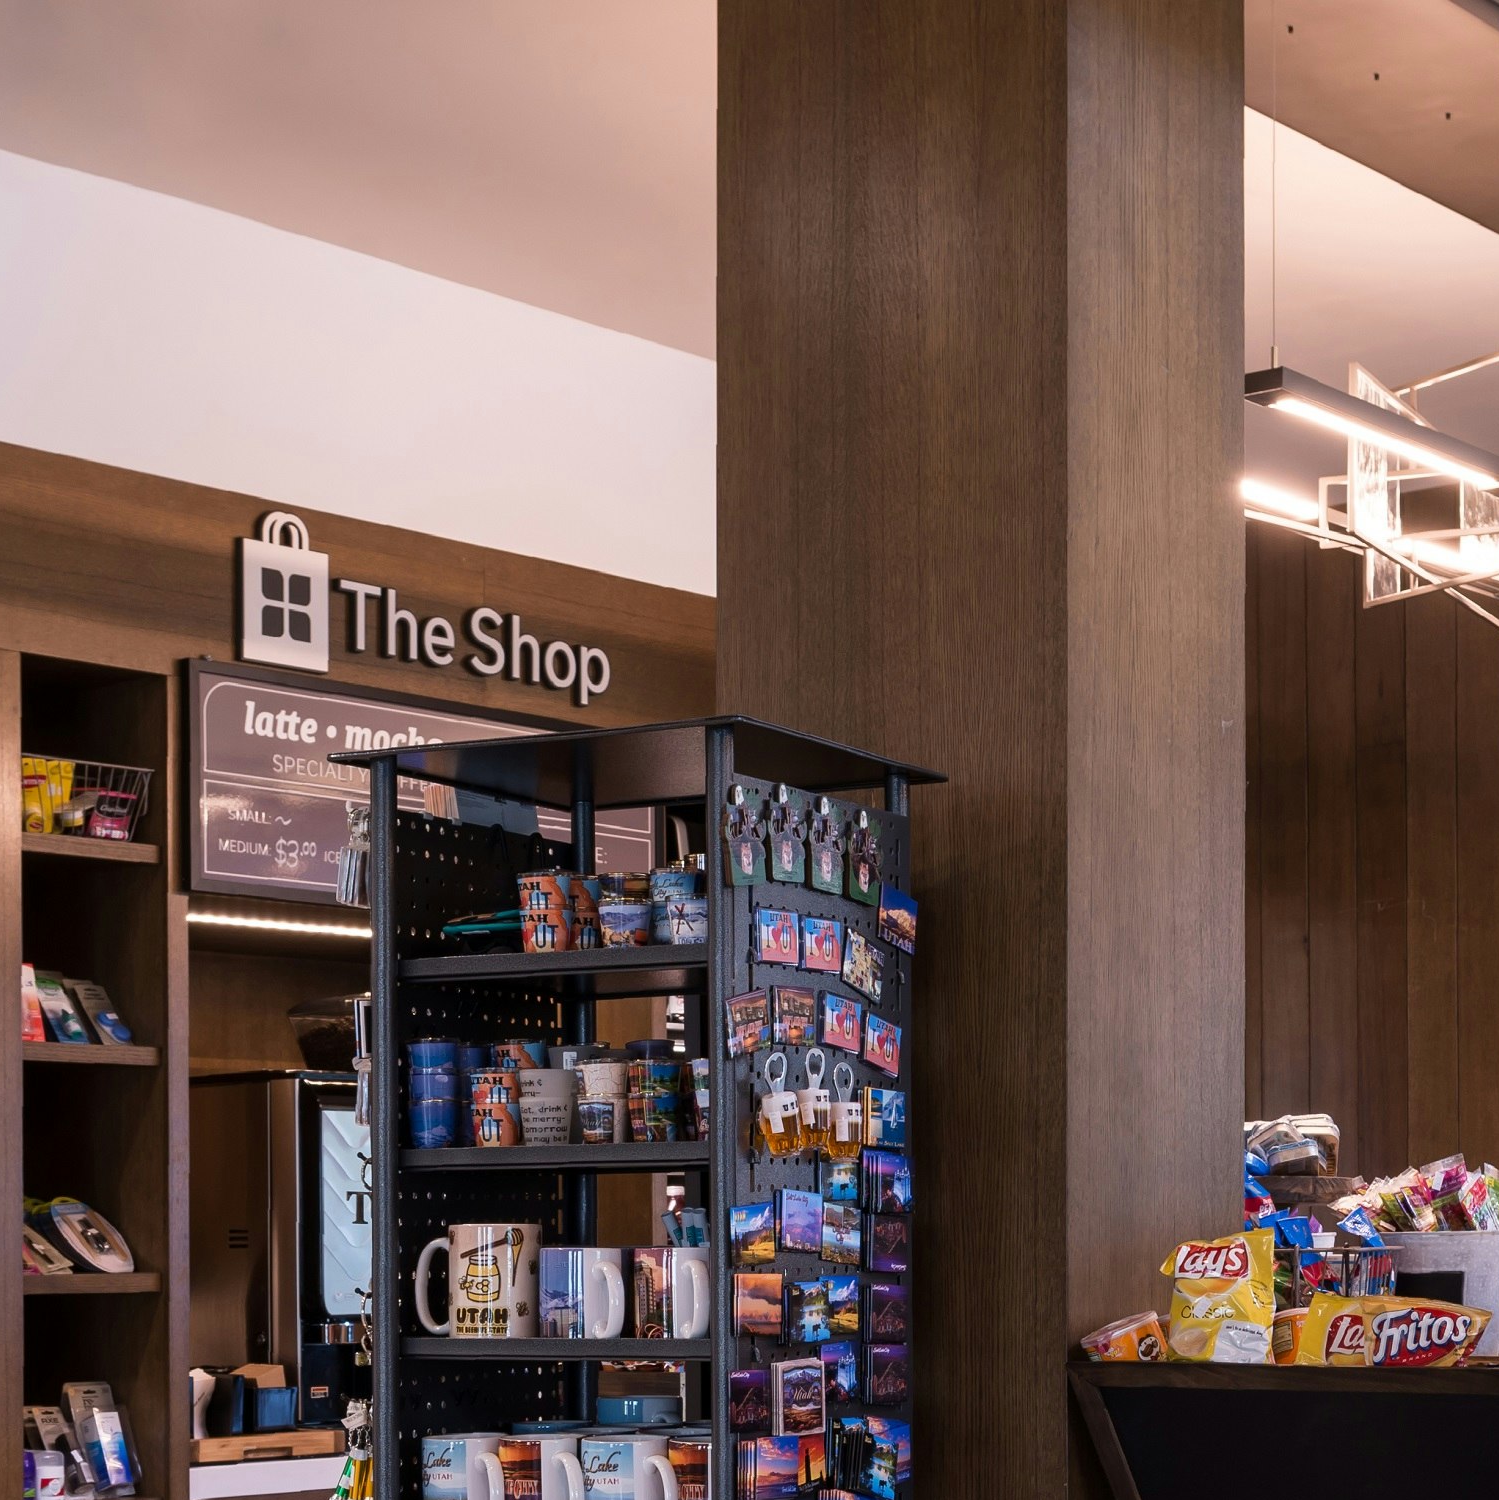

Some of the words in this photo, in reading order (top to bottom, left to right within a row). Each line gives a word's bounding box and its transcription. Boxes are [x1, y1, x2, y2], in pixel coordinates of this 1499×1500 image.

[336, 578, 456, 667] The
[466, 606, 612, 707] Shop
[244, 700, 318, 744] latte
[344, 724, 444, 751] moch
[272, 754, 369, 783] SPECIALTY
[218, 838, 272, 857] MEDIUM:
[521, 913, 549, 925] TAH
[769, 912, 790, 923] UTAH
[812, 920, 832, 932] UTAH
[534, 925, 559, 949] UT
[883, 931, 913, 951] UTAH
[834, 998, 853, 1012] UTAH
[875, 1019, 895, 1034] UTAH
[481, 1118, 503, 1143] UT
[1175, 1243, 1246, 1279] Lay's
[456, 1307, 508, 1324] UTAH
[1181, 1304, 1235, 1319] Clssic
[1372, 1307, 1472, 1366] Fritos
[1403, 1352, 1434, 1364] BRAND
[586, 1451, 622, 1474] Lake
[432, 1473, 454, 1481] UTAH
[597, 1478, 620, 1486] UTAH
